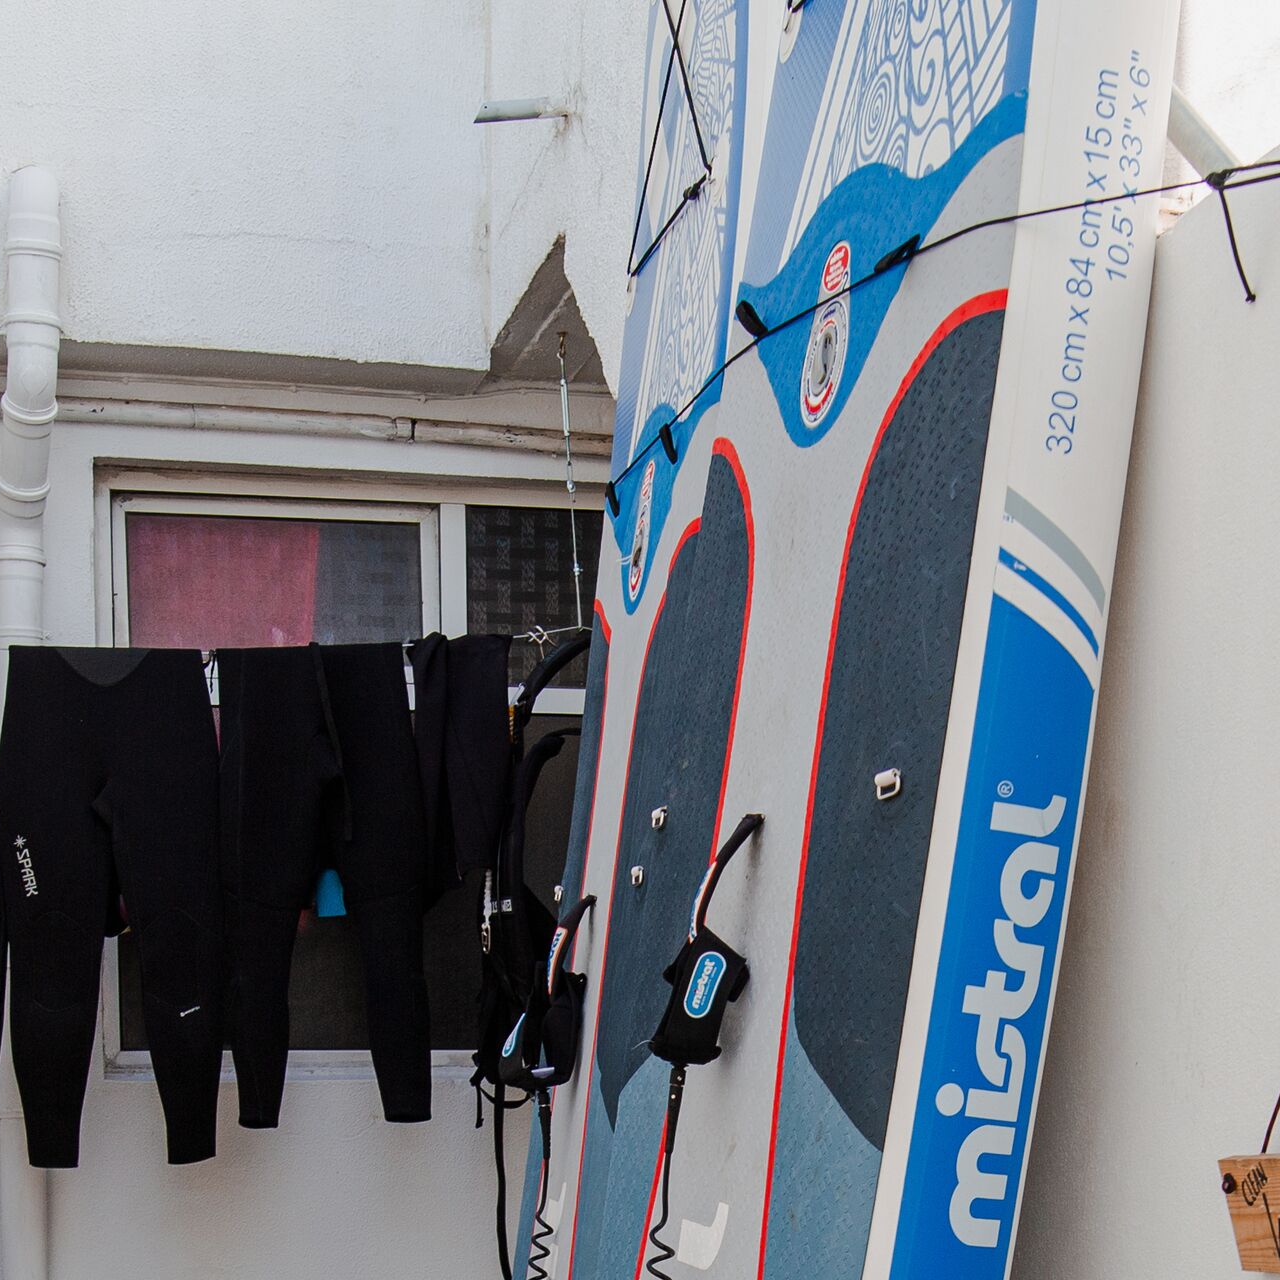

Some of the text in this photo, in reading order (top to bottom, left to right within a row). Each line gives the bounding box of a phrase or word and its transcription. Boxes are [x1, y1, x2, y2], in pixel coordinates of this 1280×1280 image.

[1129, 50, 1150, 88] 6"
[1130, 93, 1148, 116] x
[1120, 117, 1143, 177] 33"
[1122, 182, 1139, 205] x
[1046, 69, 1119, 455] 320 cm x 84 cm x 15 cm
[16, 848, 38, 898] SPARK
[692, 959, 715, 1009] mistral
[935, 794, 1067, 1249] mistral
[1241, 1161, 1268, 1206] CLEAN
